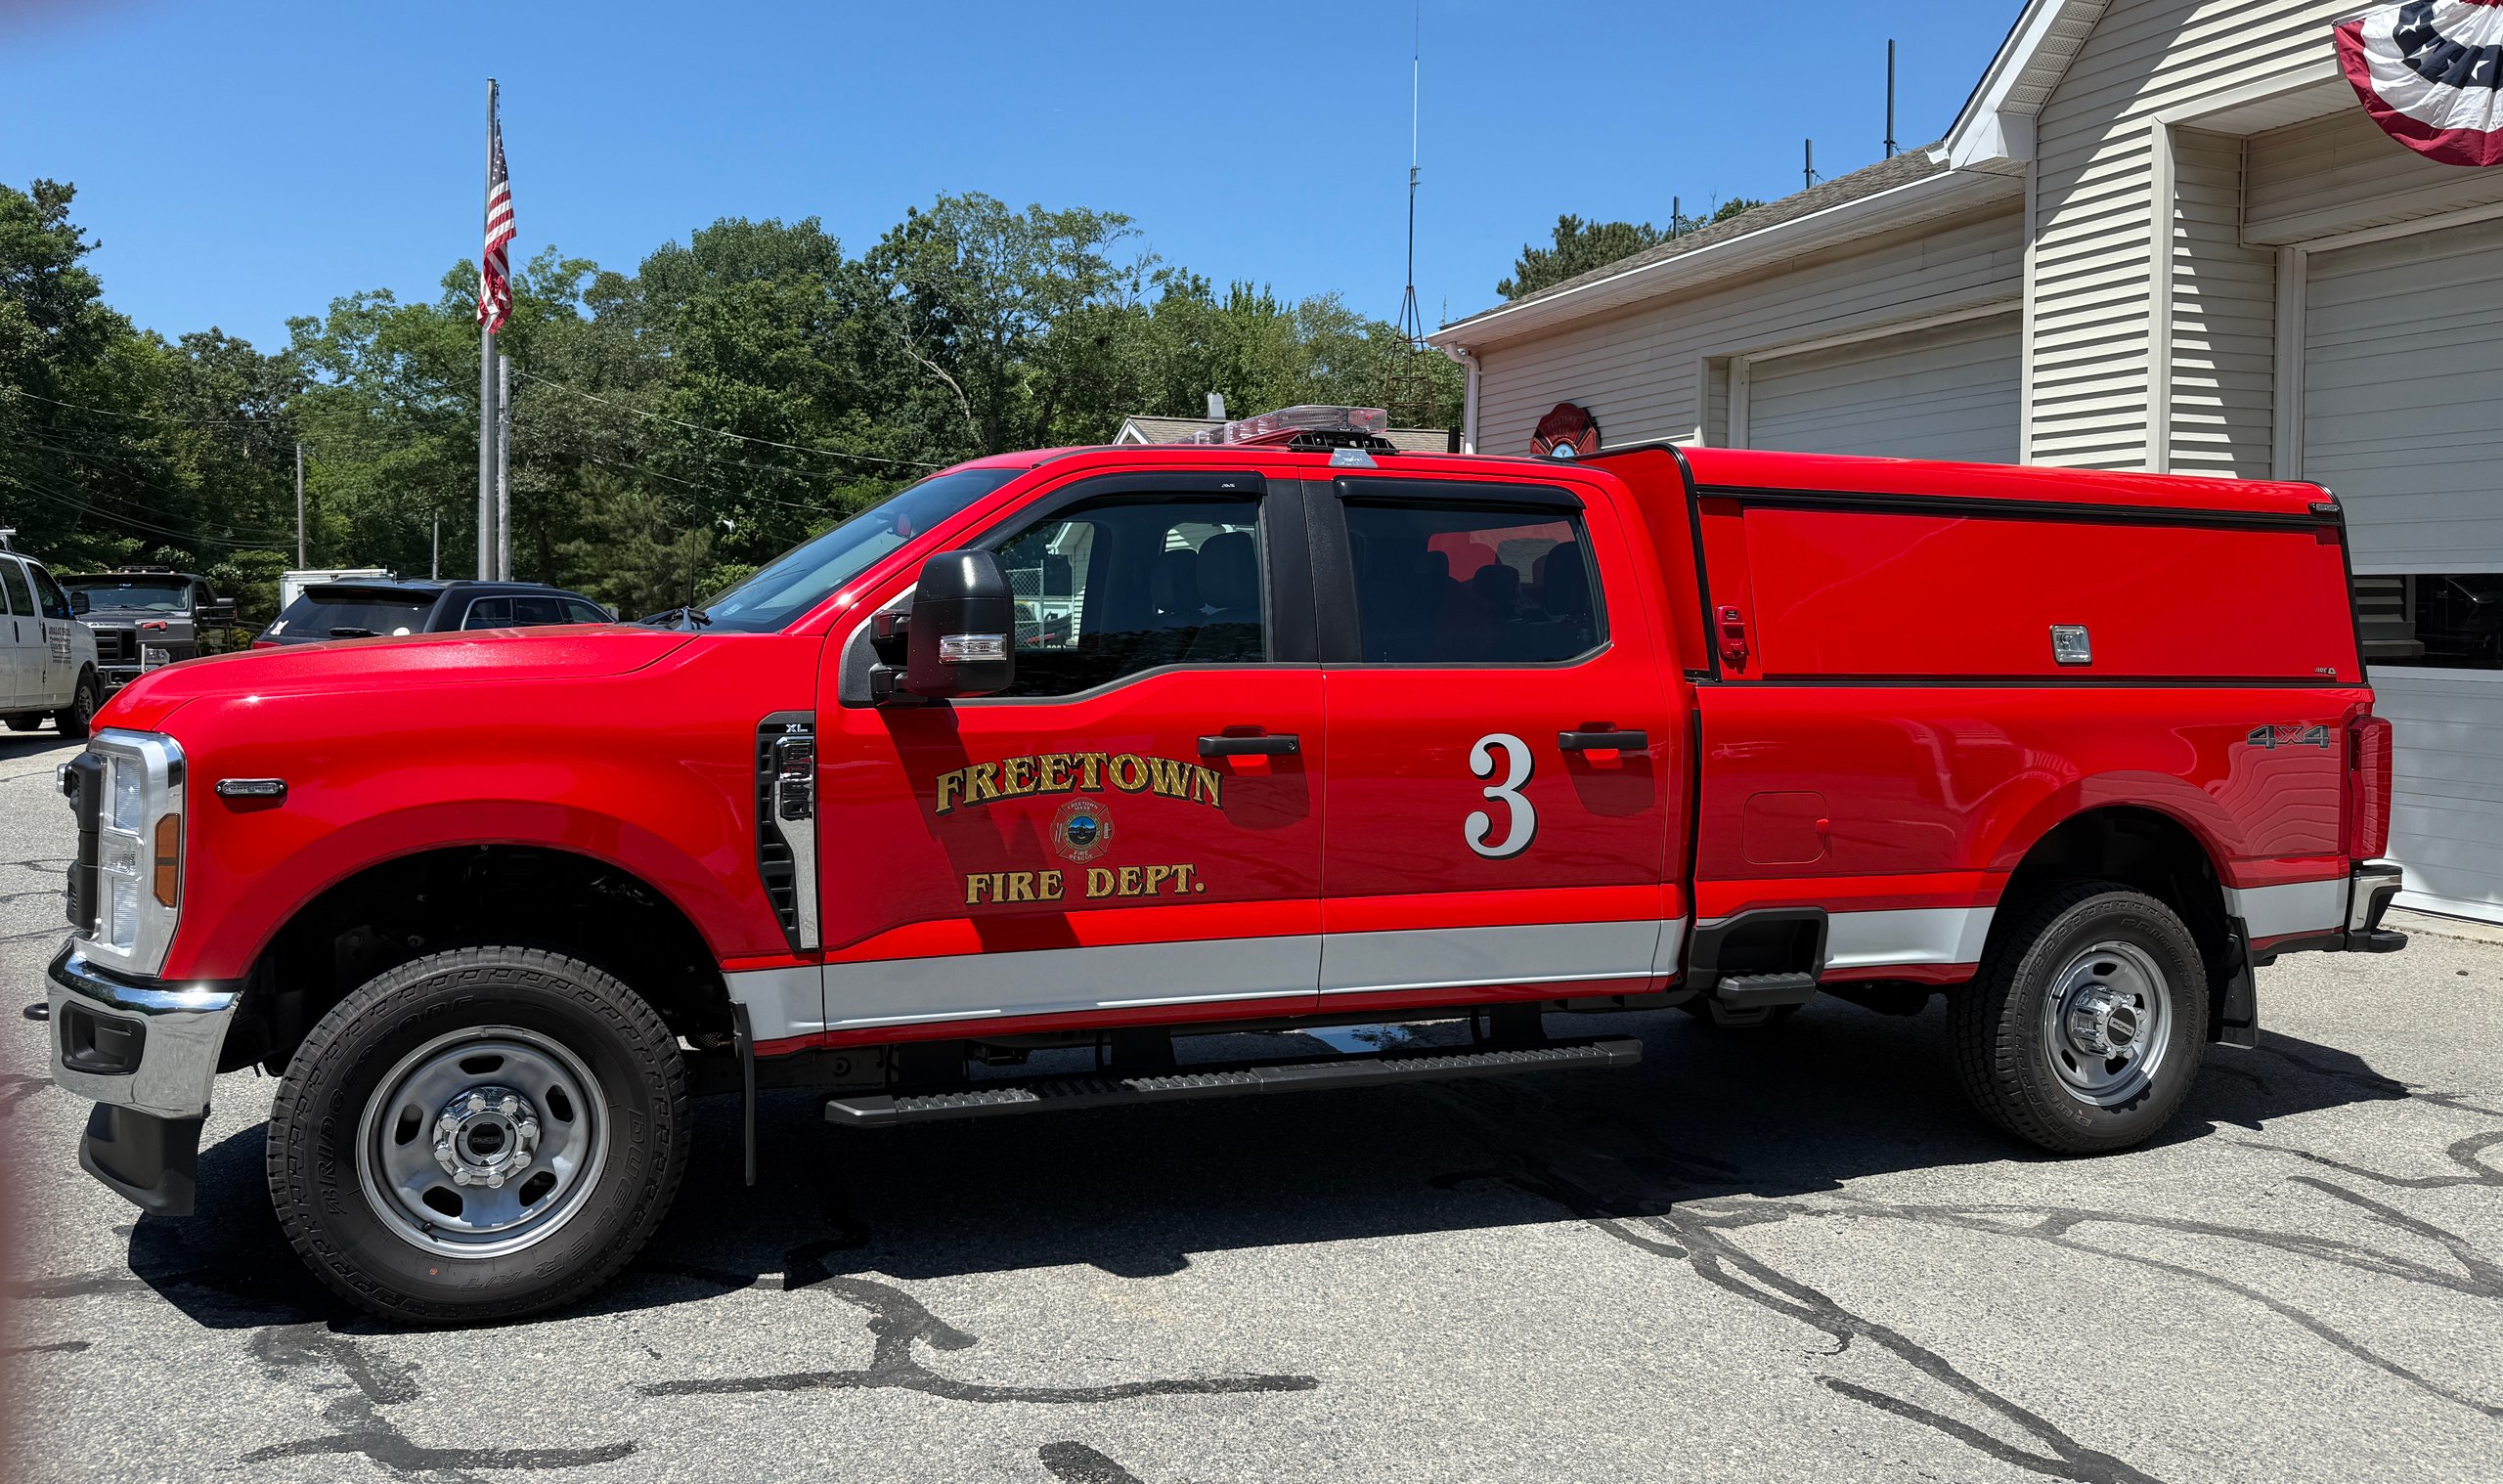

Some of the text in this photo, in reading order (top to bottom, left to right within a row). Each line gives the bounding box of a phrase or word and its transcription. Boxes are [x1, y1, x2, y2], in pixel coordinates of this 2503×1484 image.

[785, 723, 809, 733] XL
[934, 752, 1224, 816] FREETOWN
[1464, 732, 1538, 860] 3
[964, 862, 1208, 904] FIRE DEPT.
[2112, 1021, 2132, 1033] FORD
[535, 1108, 646, 1280] DUELER
